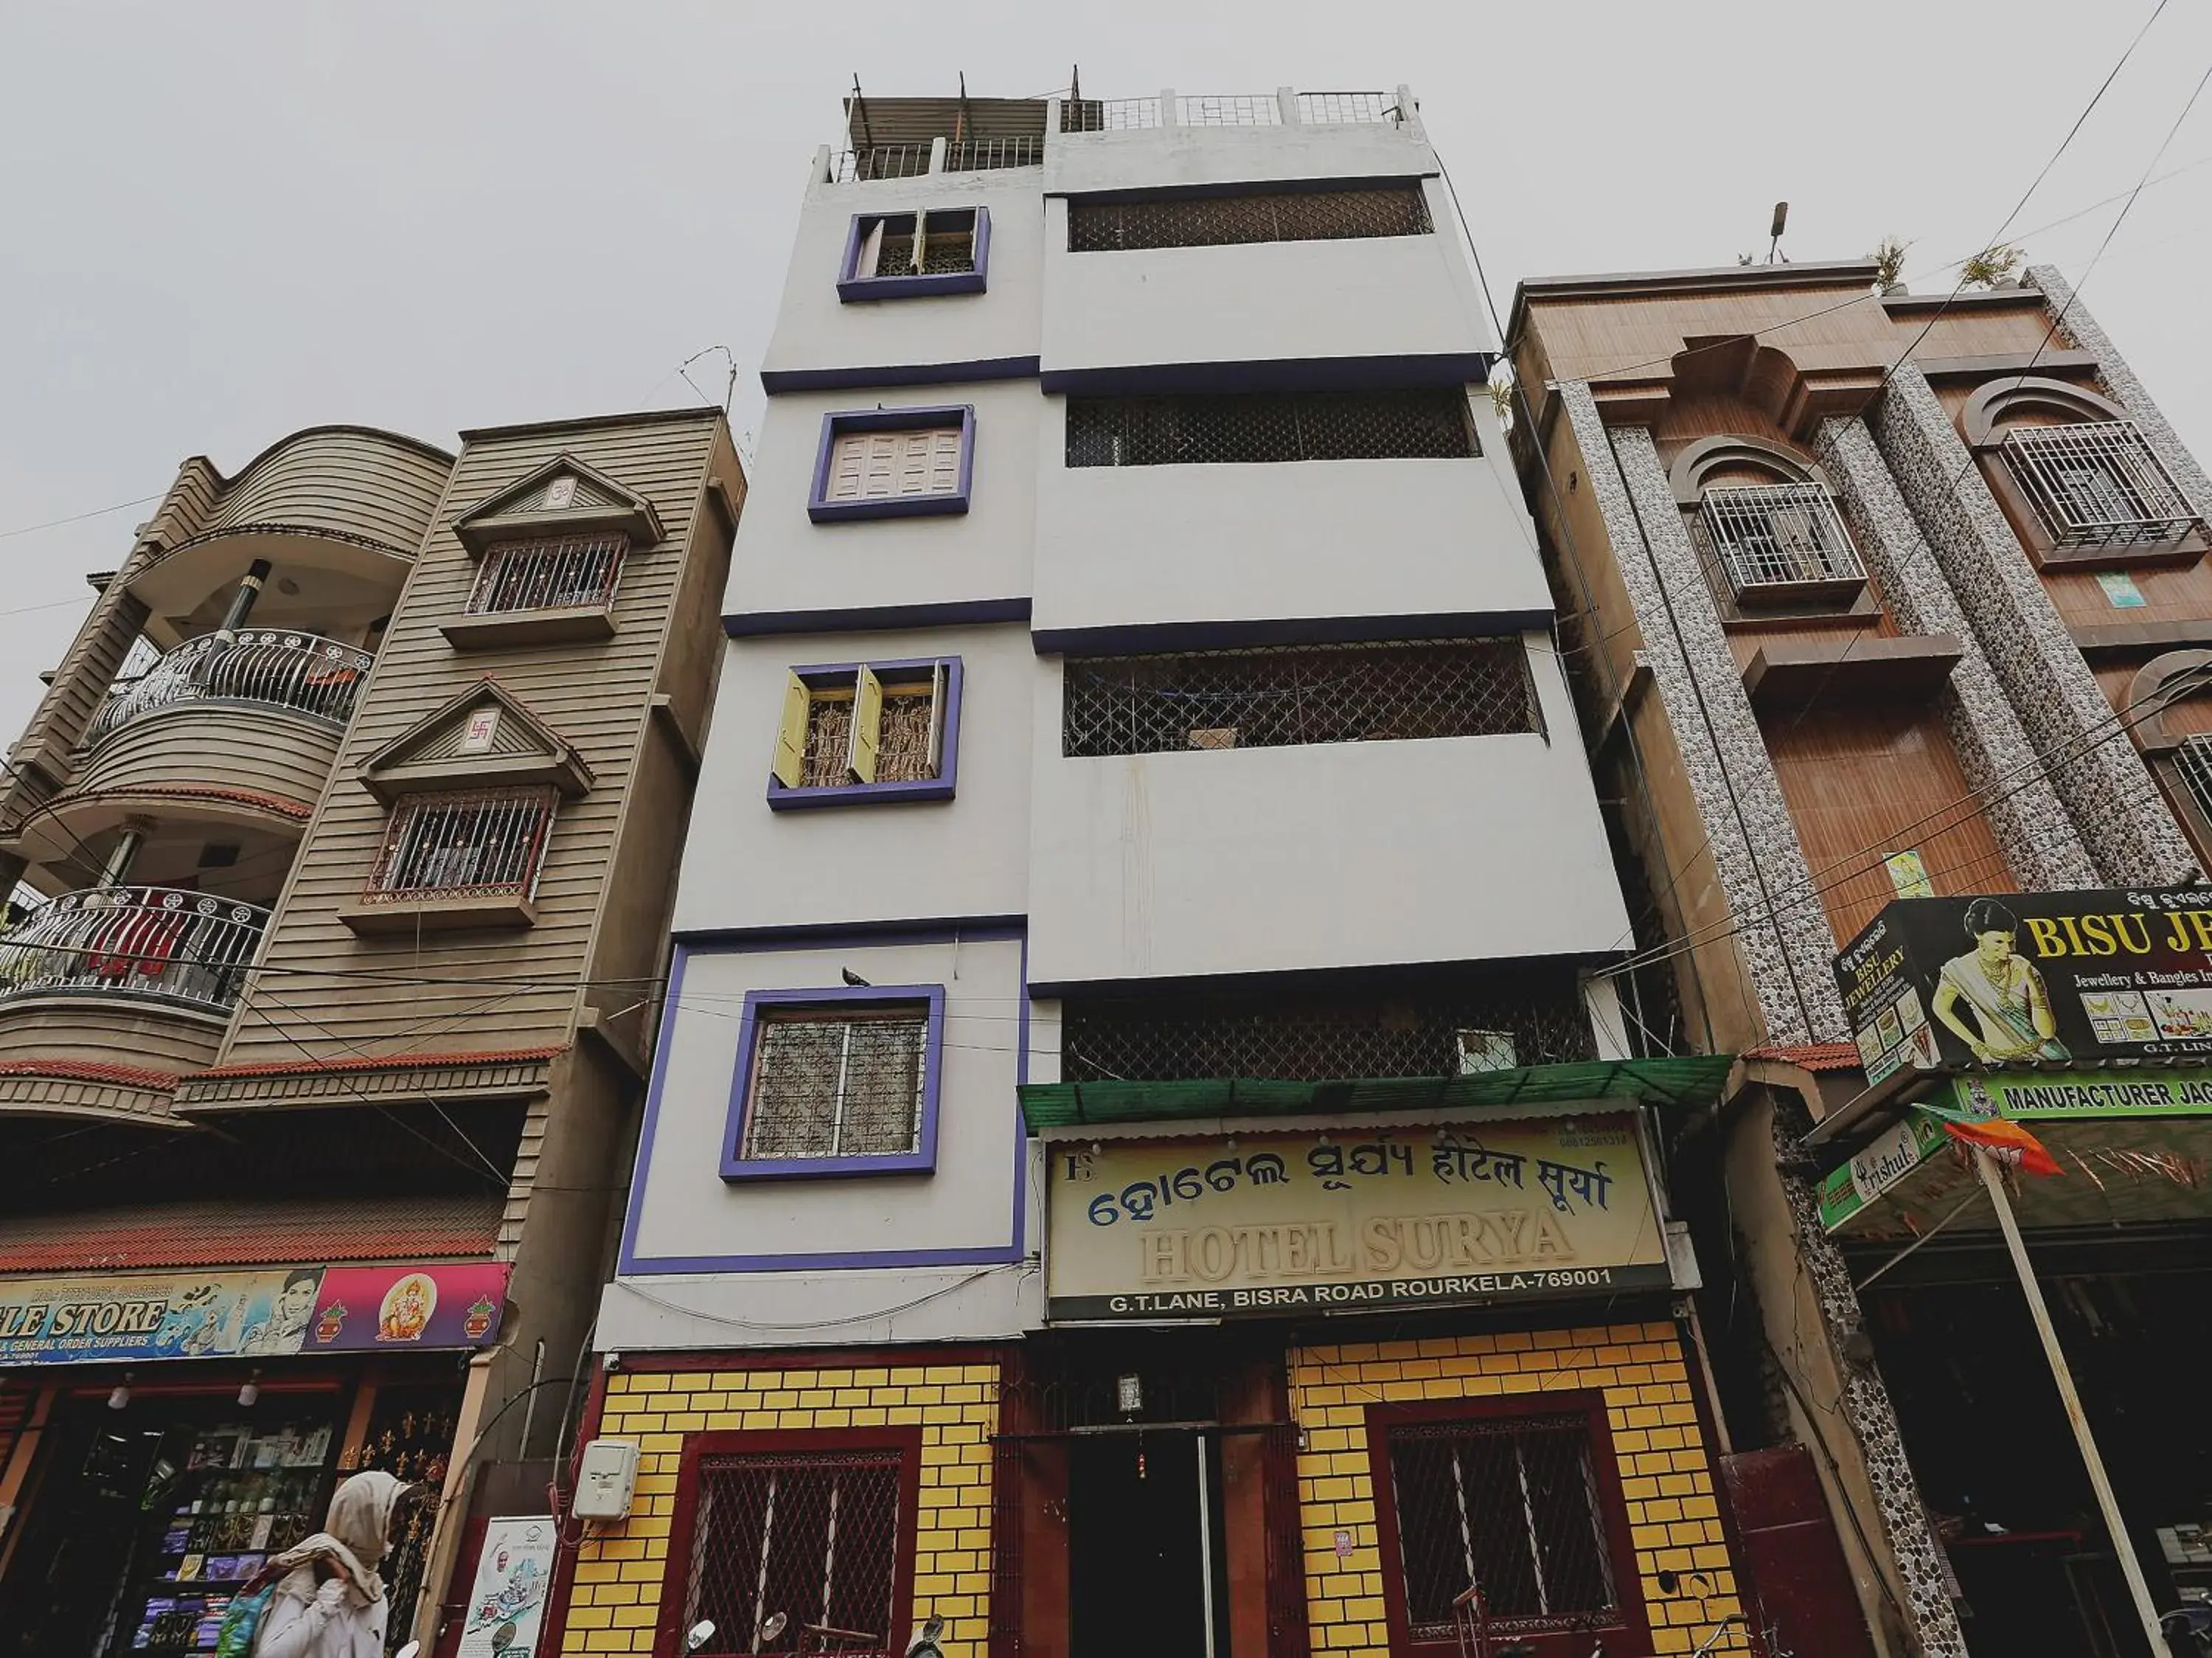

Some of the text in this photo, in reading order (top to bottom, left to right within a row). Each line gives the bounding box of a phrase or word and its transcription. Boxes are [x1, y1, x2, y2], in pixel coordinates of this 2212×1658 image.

[2023, 913, 2152, 958] BISU
[1845, 946, 1905, 1011] JEWELLERY
[1855, 951, 1881, 984] BISU
[2073, 974, 2131, 990] Jewellery
[2135, 971, 2146, 985] &
[2148, 970, 2199, 988] Bangles
[2143, 1043, 2179, 1052] G.T.
[2002, 1083, 2175, 1111] MANUFACTURER
[1088, 1152, 1291, 1227] ହୋଟେଲ
[1537, 1160, 1613, 1216] सूर्या
[1139, 1206, 1577, 1284] HOTEL SURYA
[1110, 1268, 1612, 1313] G.T.LANE, BISRA ROAD ROURKELA-769001
[0, 1300, 168, 1339] LE STORE
[10, 1338, 55, 1352] GENERAL
[58, 1337, 93, 1350] ORDER
[94, 1336, 147, 1349] SUPPLIERS
